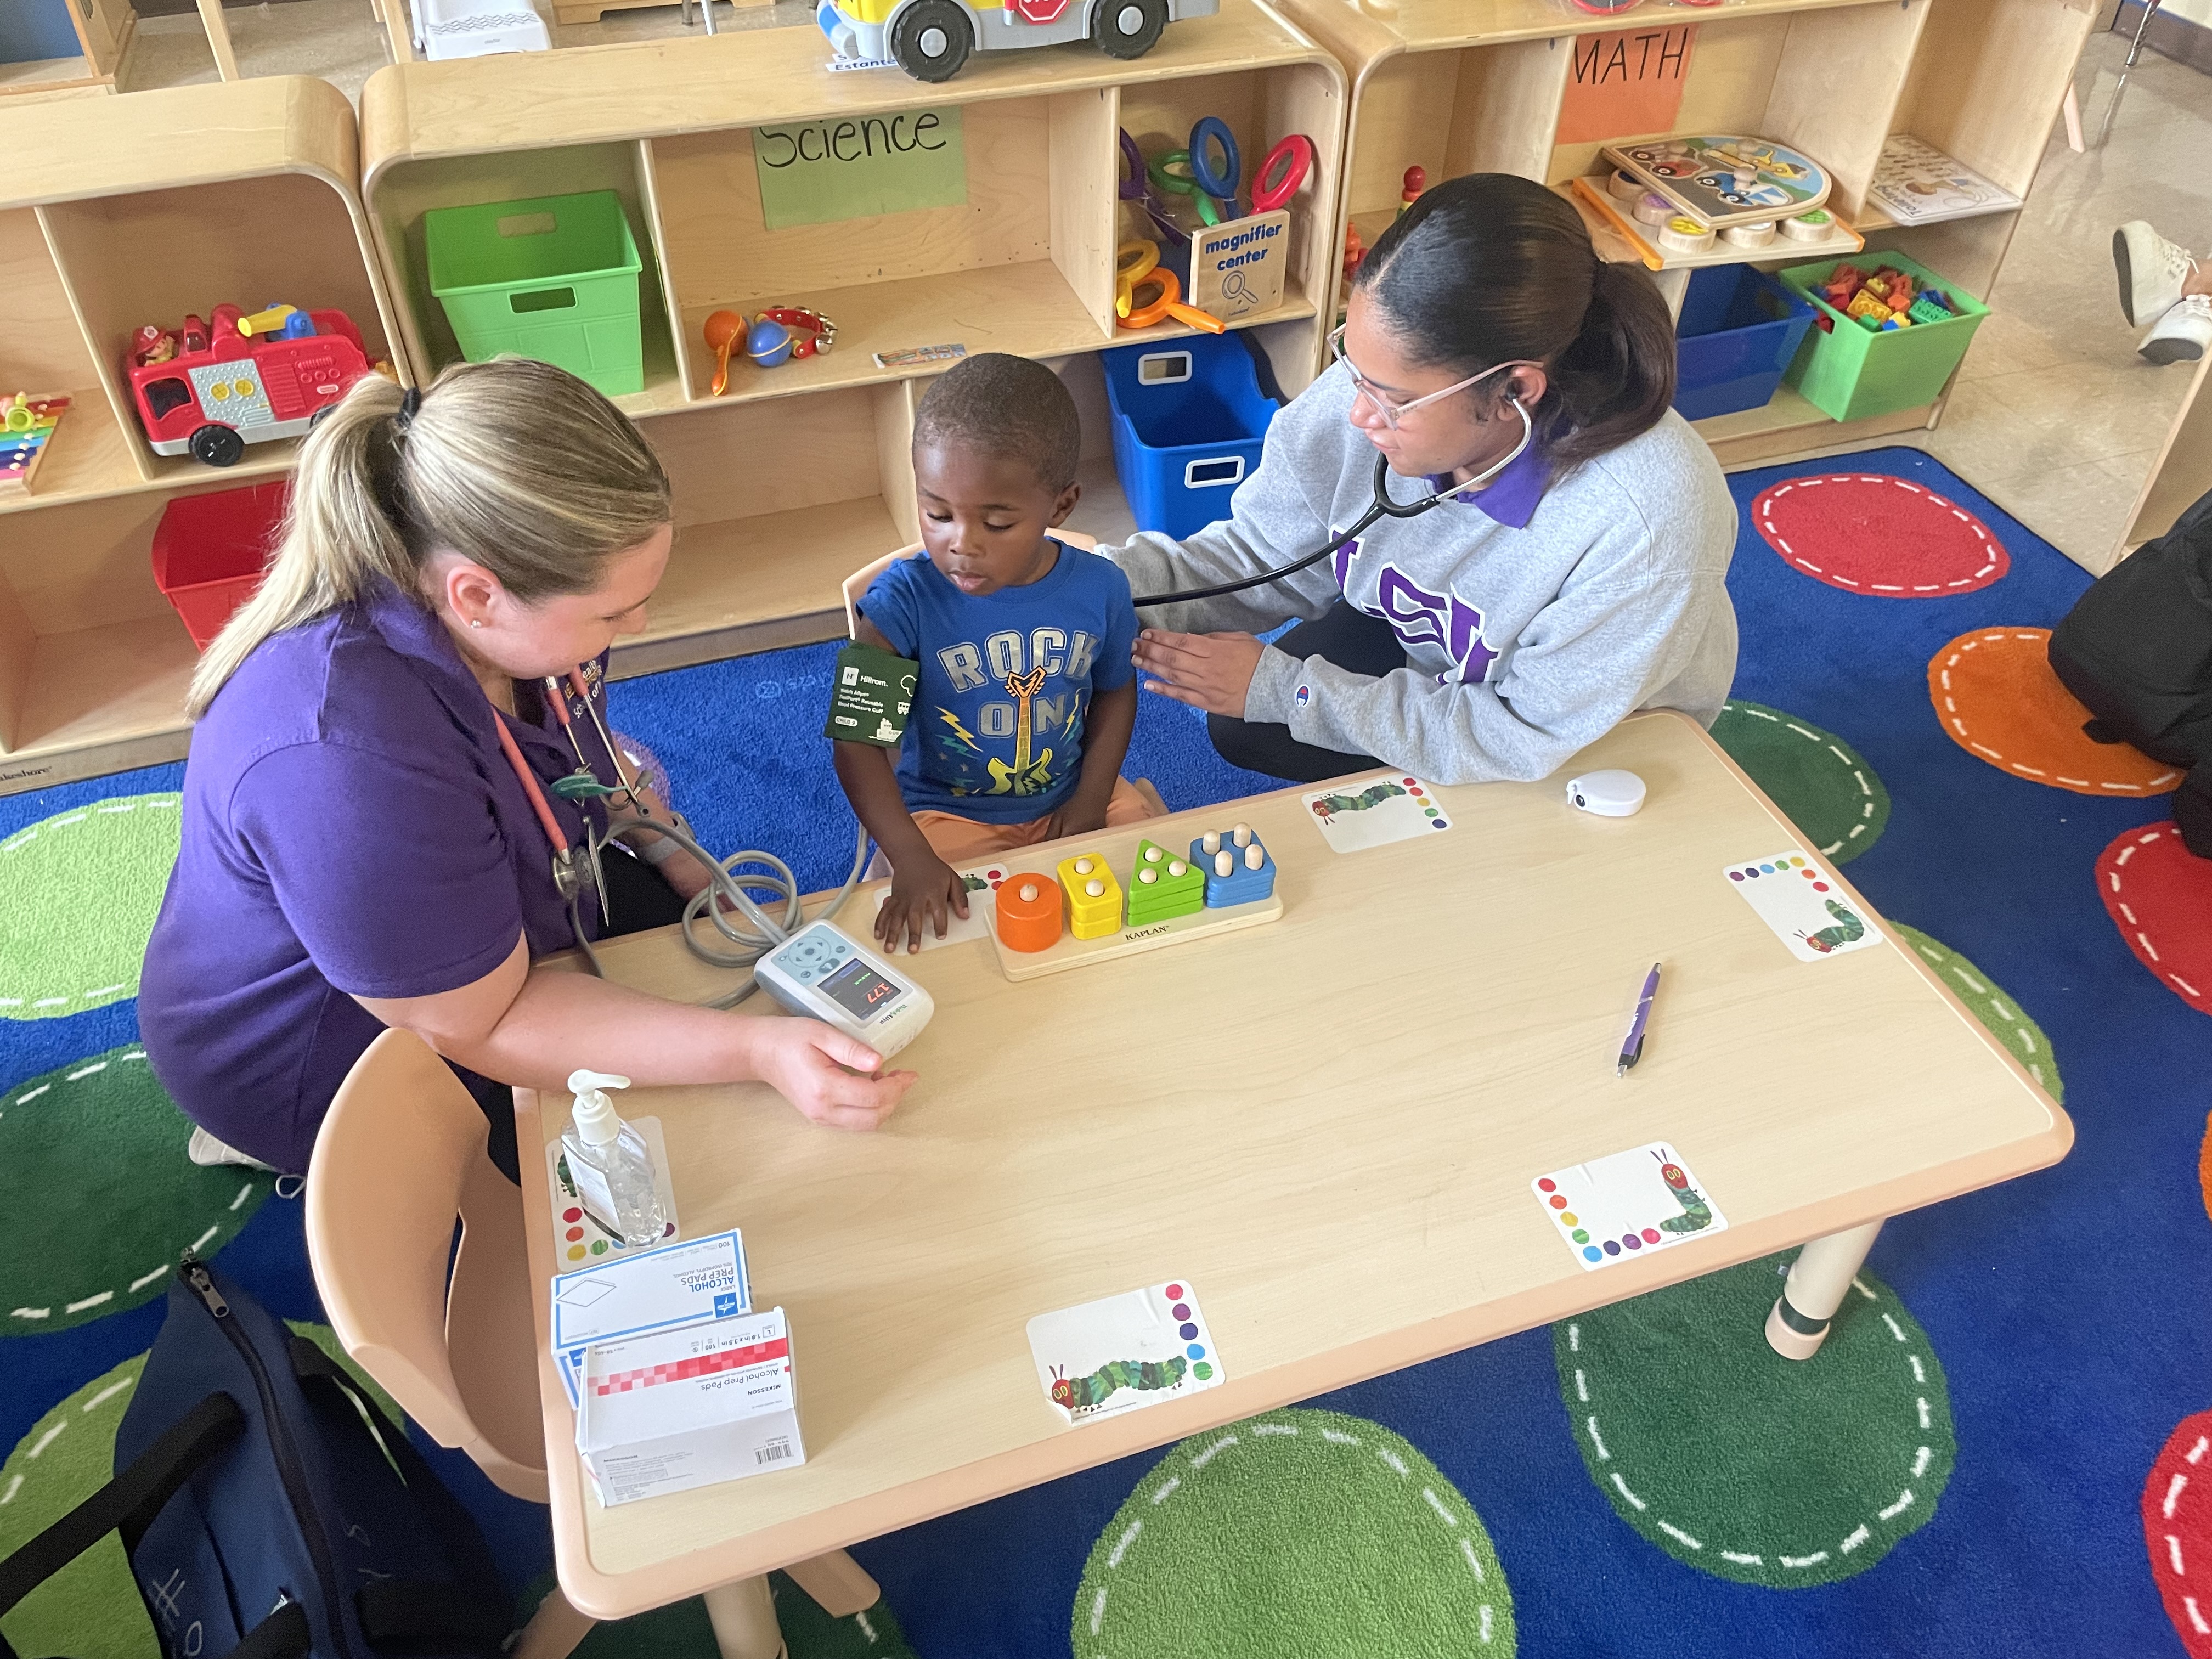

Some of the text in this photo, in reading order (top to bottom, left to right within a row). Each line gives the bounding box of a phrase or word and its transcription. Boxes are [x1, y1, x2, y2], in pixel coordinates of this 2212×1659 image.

[1574, 27, 1689, 84] MATH
[759, 113, 947, 168] Science
[1206, 224, 1282, 254] magnifier
[1217, 249, 1268, 271] center
[937, 627, 1100, 693] ROCK
[978, 693, 1068, 739] ON
[867, 983, 889, 1003] 177
[681, 1267, 733, 1286] PREP PADS
[689, 1276, 734, 1293] ALCOHOL
[724, 1376, 744, 1385] Prep
[746, 1368, 779, 1382] Alcohol
[701, 1381, 722, 1391] Pads
